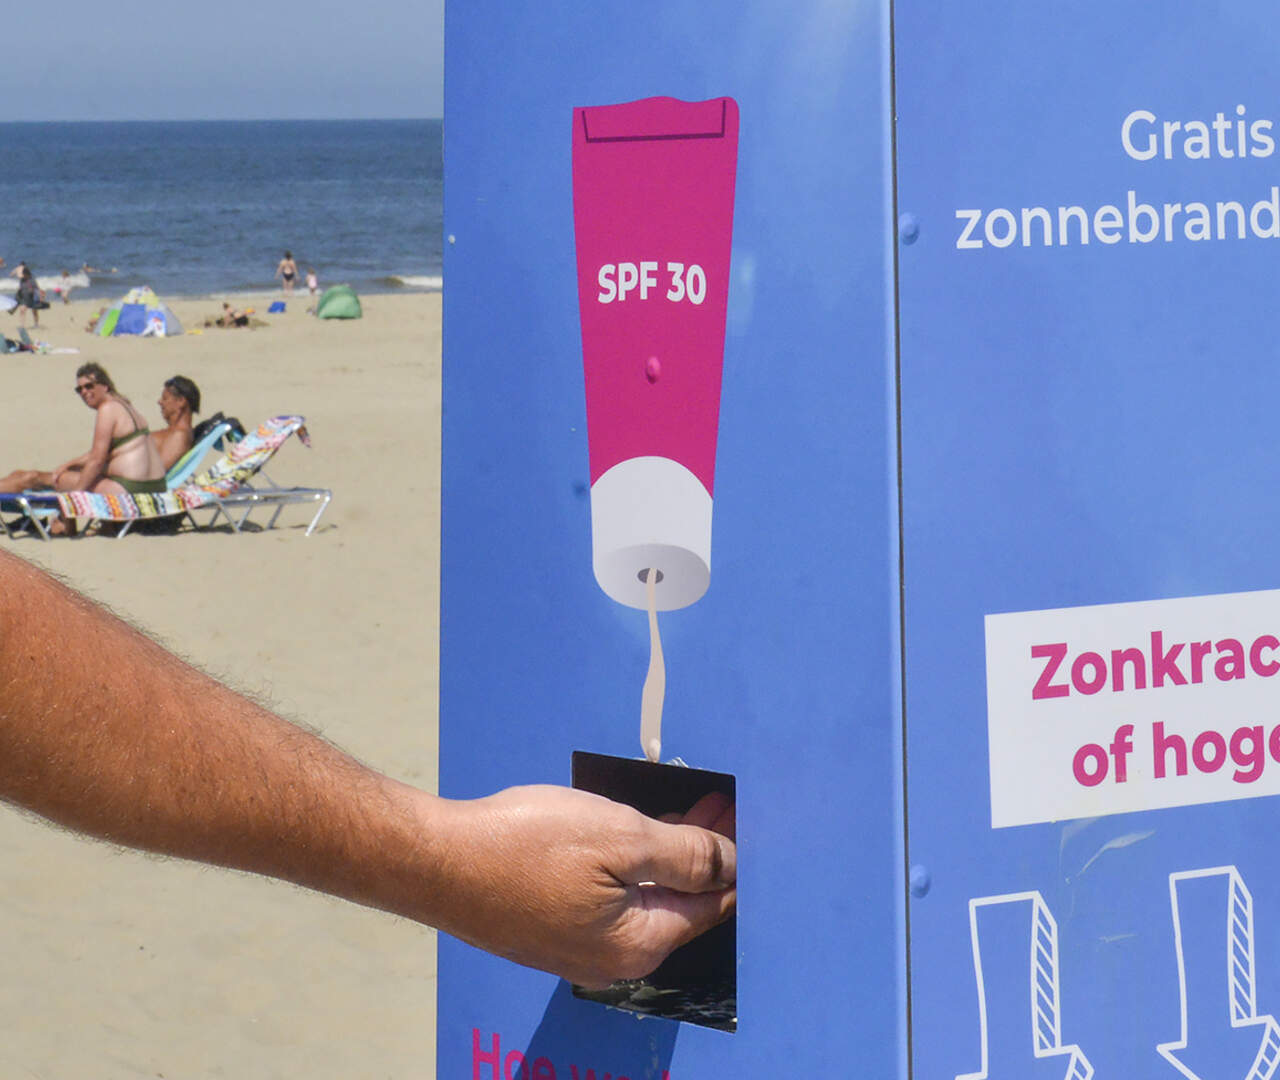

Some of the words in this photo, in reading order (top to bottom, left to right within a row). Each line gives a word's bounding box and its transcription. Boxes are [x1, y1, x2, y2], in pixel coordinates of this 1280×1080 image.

[1120, 104, 1275, 161] Gratis
[597, 261, 658, 304] SPF
[666, 261, 708, 305] 30
[1072, 724, 1135, 787] of
